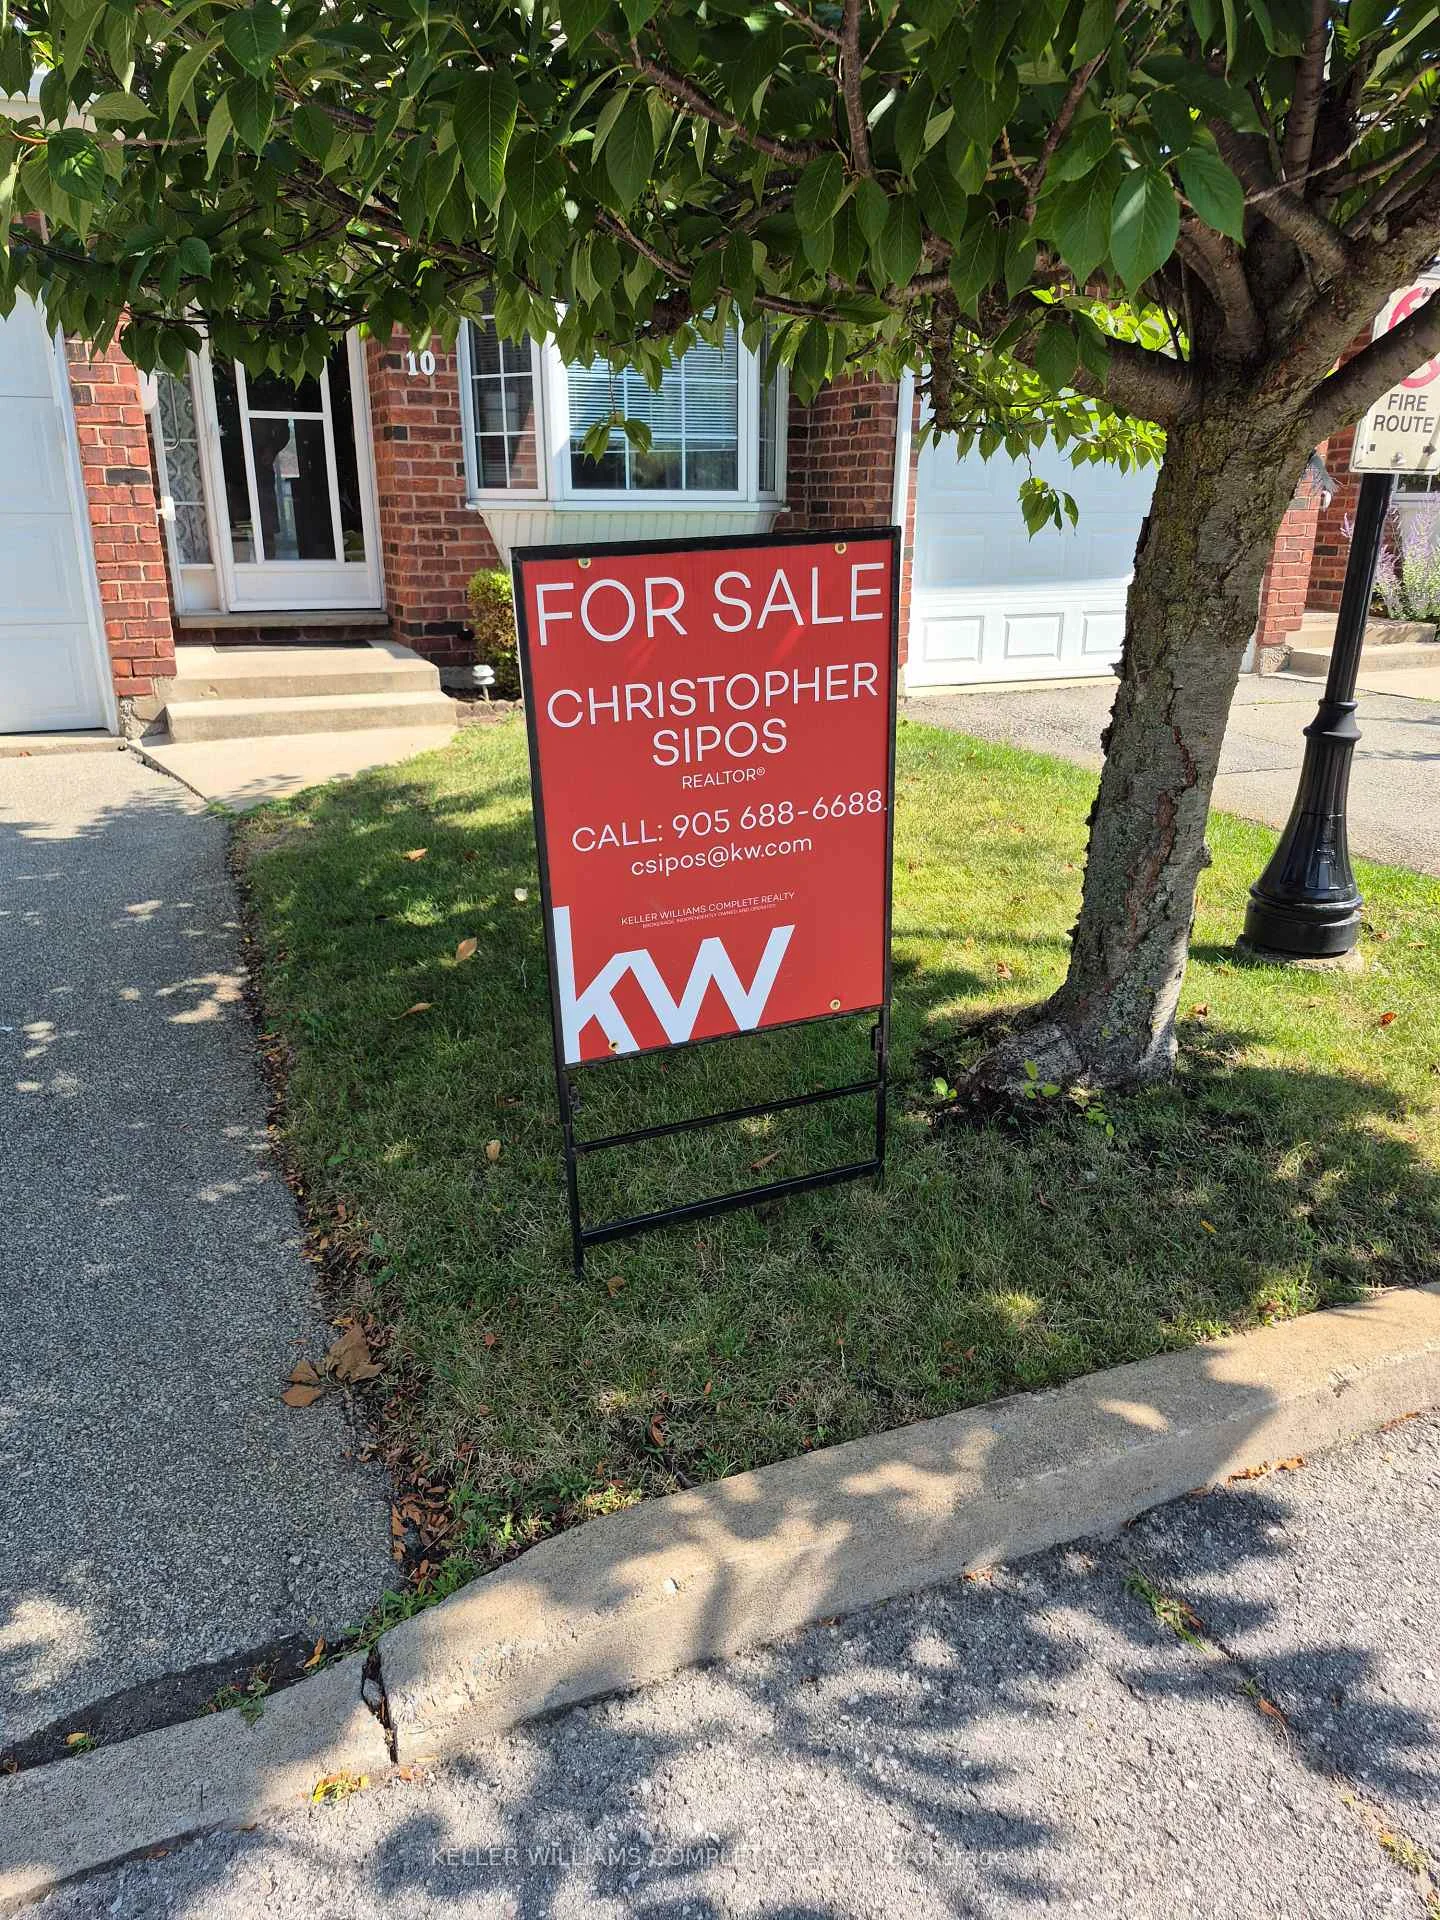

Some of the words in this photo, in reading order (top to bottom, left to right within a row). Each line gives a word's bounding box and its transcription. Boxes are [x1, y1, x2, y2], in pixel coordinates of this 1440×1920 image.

[406, 350, 436, 376] 10
[1373, 414, 1435, 433] ROUTE
[1387, 393, 1429, 412] FIRE
[535, 576, 688, 646] FOR
[712, 561, 885, 634] SALE
[547, 662, 879, 729] CHRISTOPHER
[652, 717, 788, 767] SIPOS
[571, 819, 664, 853] CALL:
[671, 808, 730, 840] 905
[630, 836, 813, 877] csipos@kw.com
[620, 913, 658, 926] KELLER
[659, 904, 707, 921] WILLIAMS
[708, 897, 760, 912] COMPLETE
[761, 891, 795, 904] REALTY
[552, 905, 796, 1065] kw
